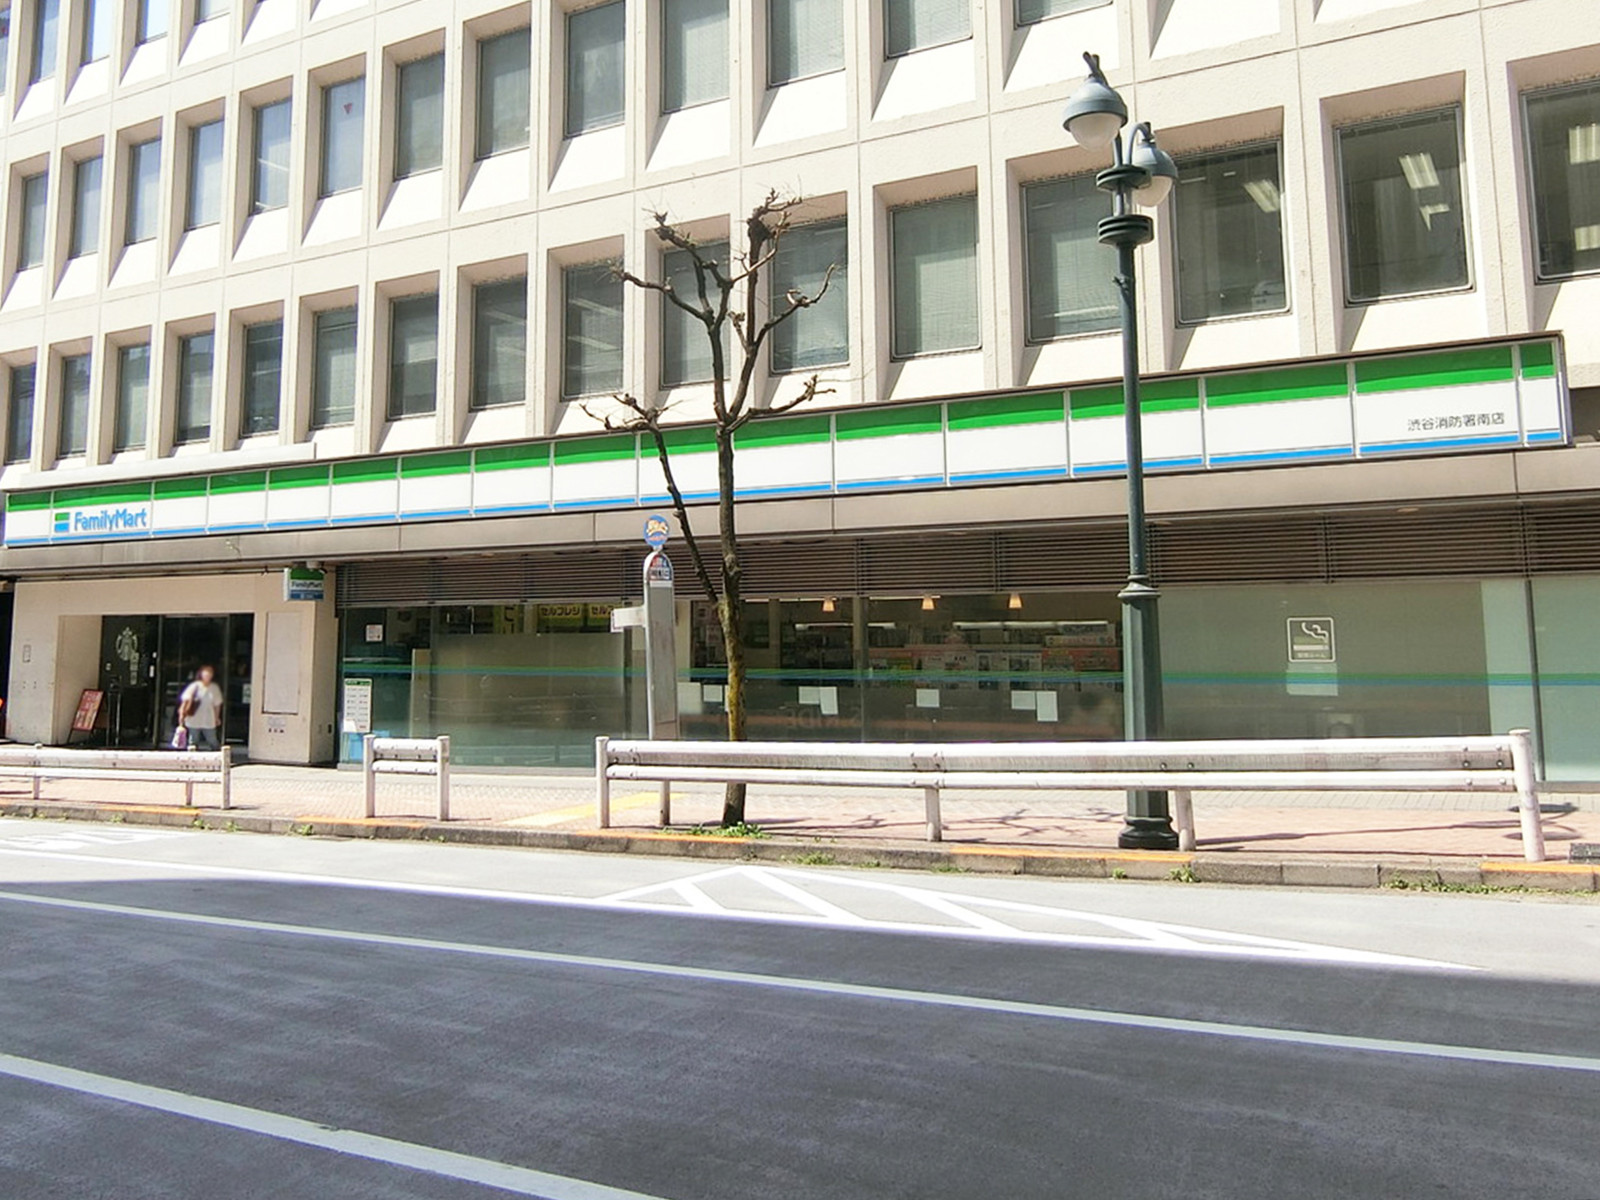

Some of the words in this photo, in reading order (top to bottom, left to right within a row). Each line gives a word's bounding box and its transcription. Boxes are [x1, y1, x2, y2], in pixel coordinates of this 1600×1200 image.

[1407, 412, 1505, 431] 渋谷消防署南店
[74, 508, 147, 532] FamilyMart
